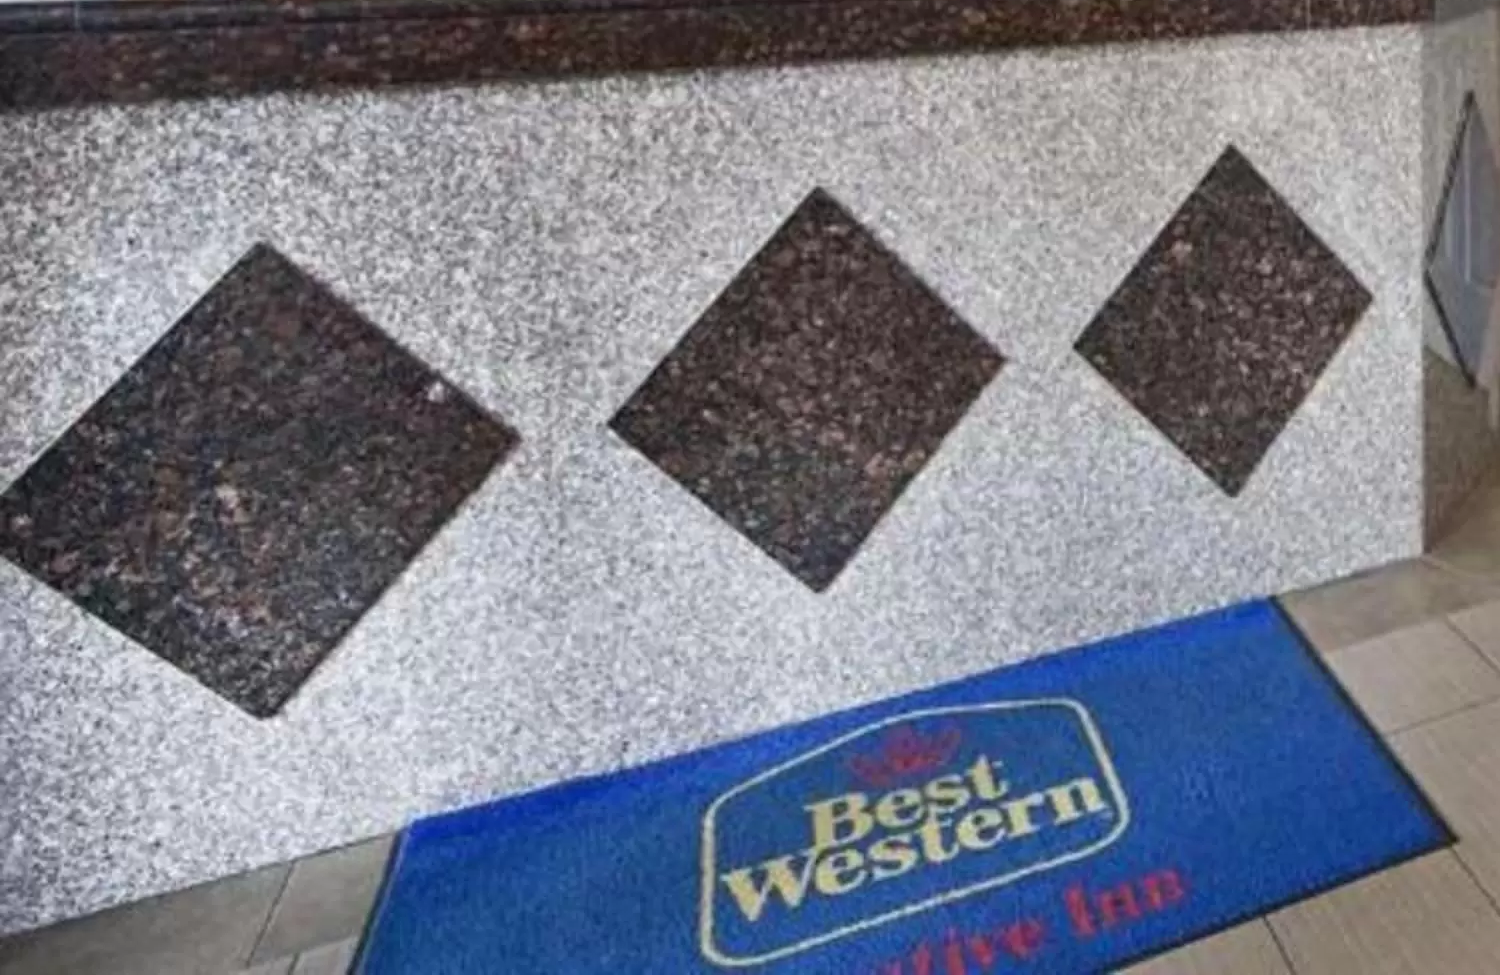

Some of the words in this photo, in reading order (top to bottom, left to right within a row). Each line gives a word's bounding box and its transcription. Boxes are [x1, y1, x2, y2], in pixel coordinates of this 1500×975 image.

[805, 754, 1008, 847] Best
[720, 777, 1106, 922] Western
[1064, 869, 1186, 939] Inn
